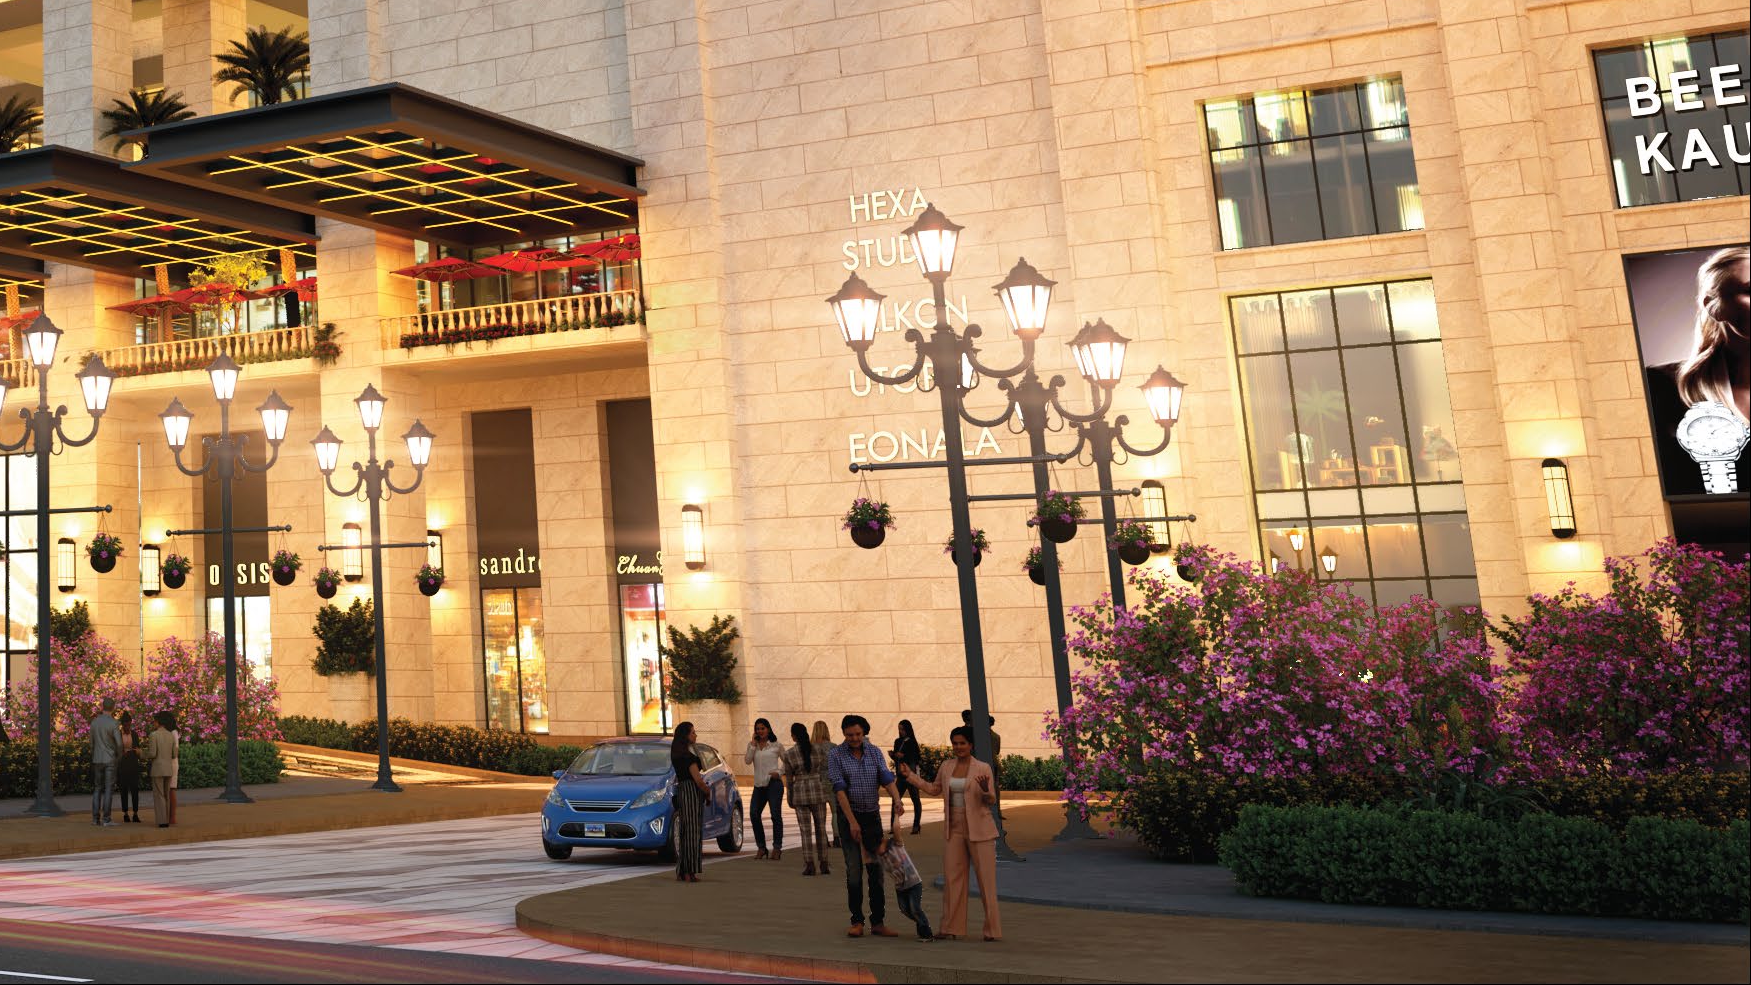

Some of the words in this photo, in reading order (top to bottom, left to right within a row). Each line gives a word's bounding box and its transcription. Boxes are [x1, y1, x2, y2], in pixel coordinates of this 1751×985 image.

[1625, 63, 1746, 117] BEE
[1635, 121, 1750, 175] KAU
[849, 186, 931, 223] HEXA
[842, 234, 917, 271] STUD
[876, 295, 968, 333] LKON
[209, 562, 270, 586] OSIS
